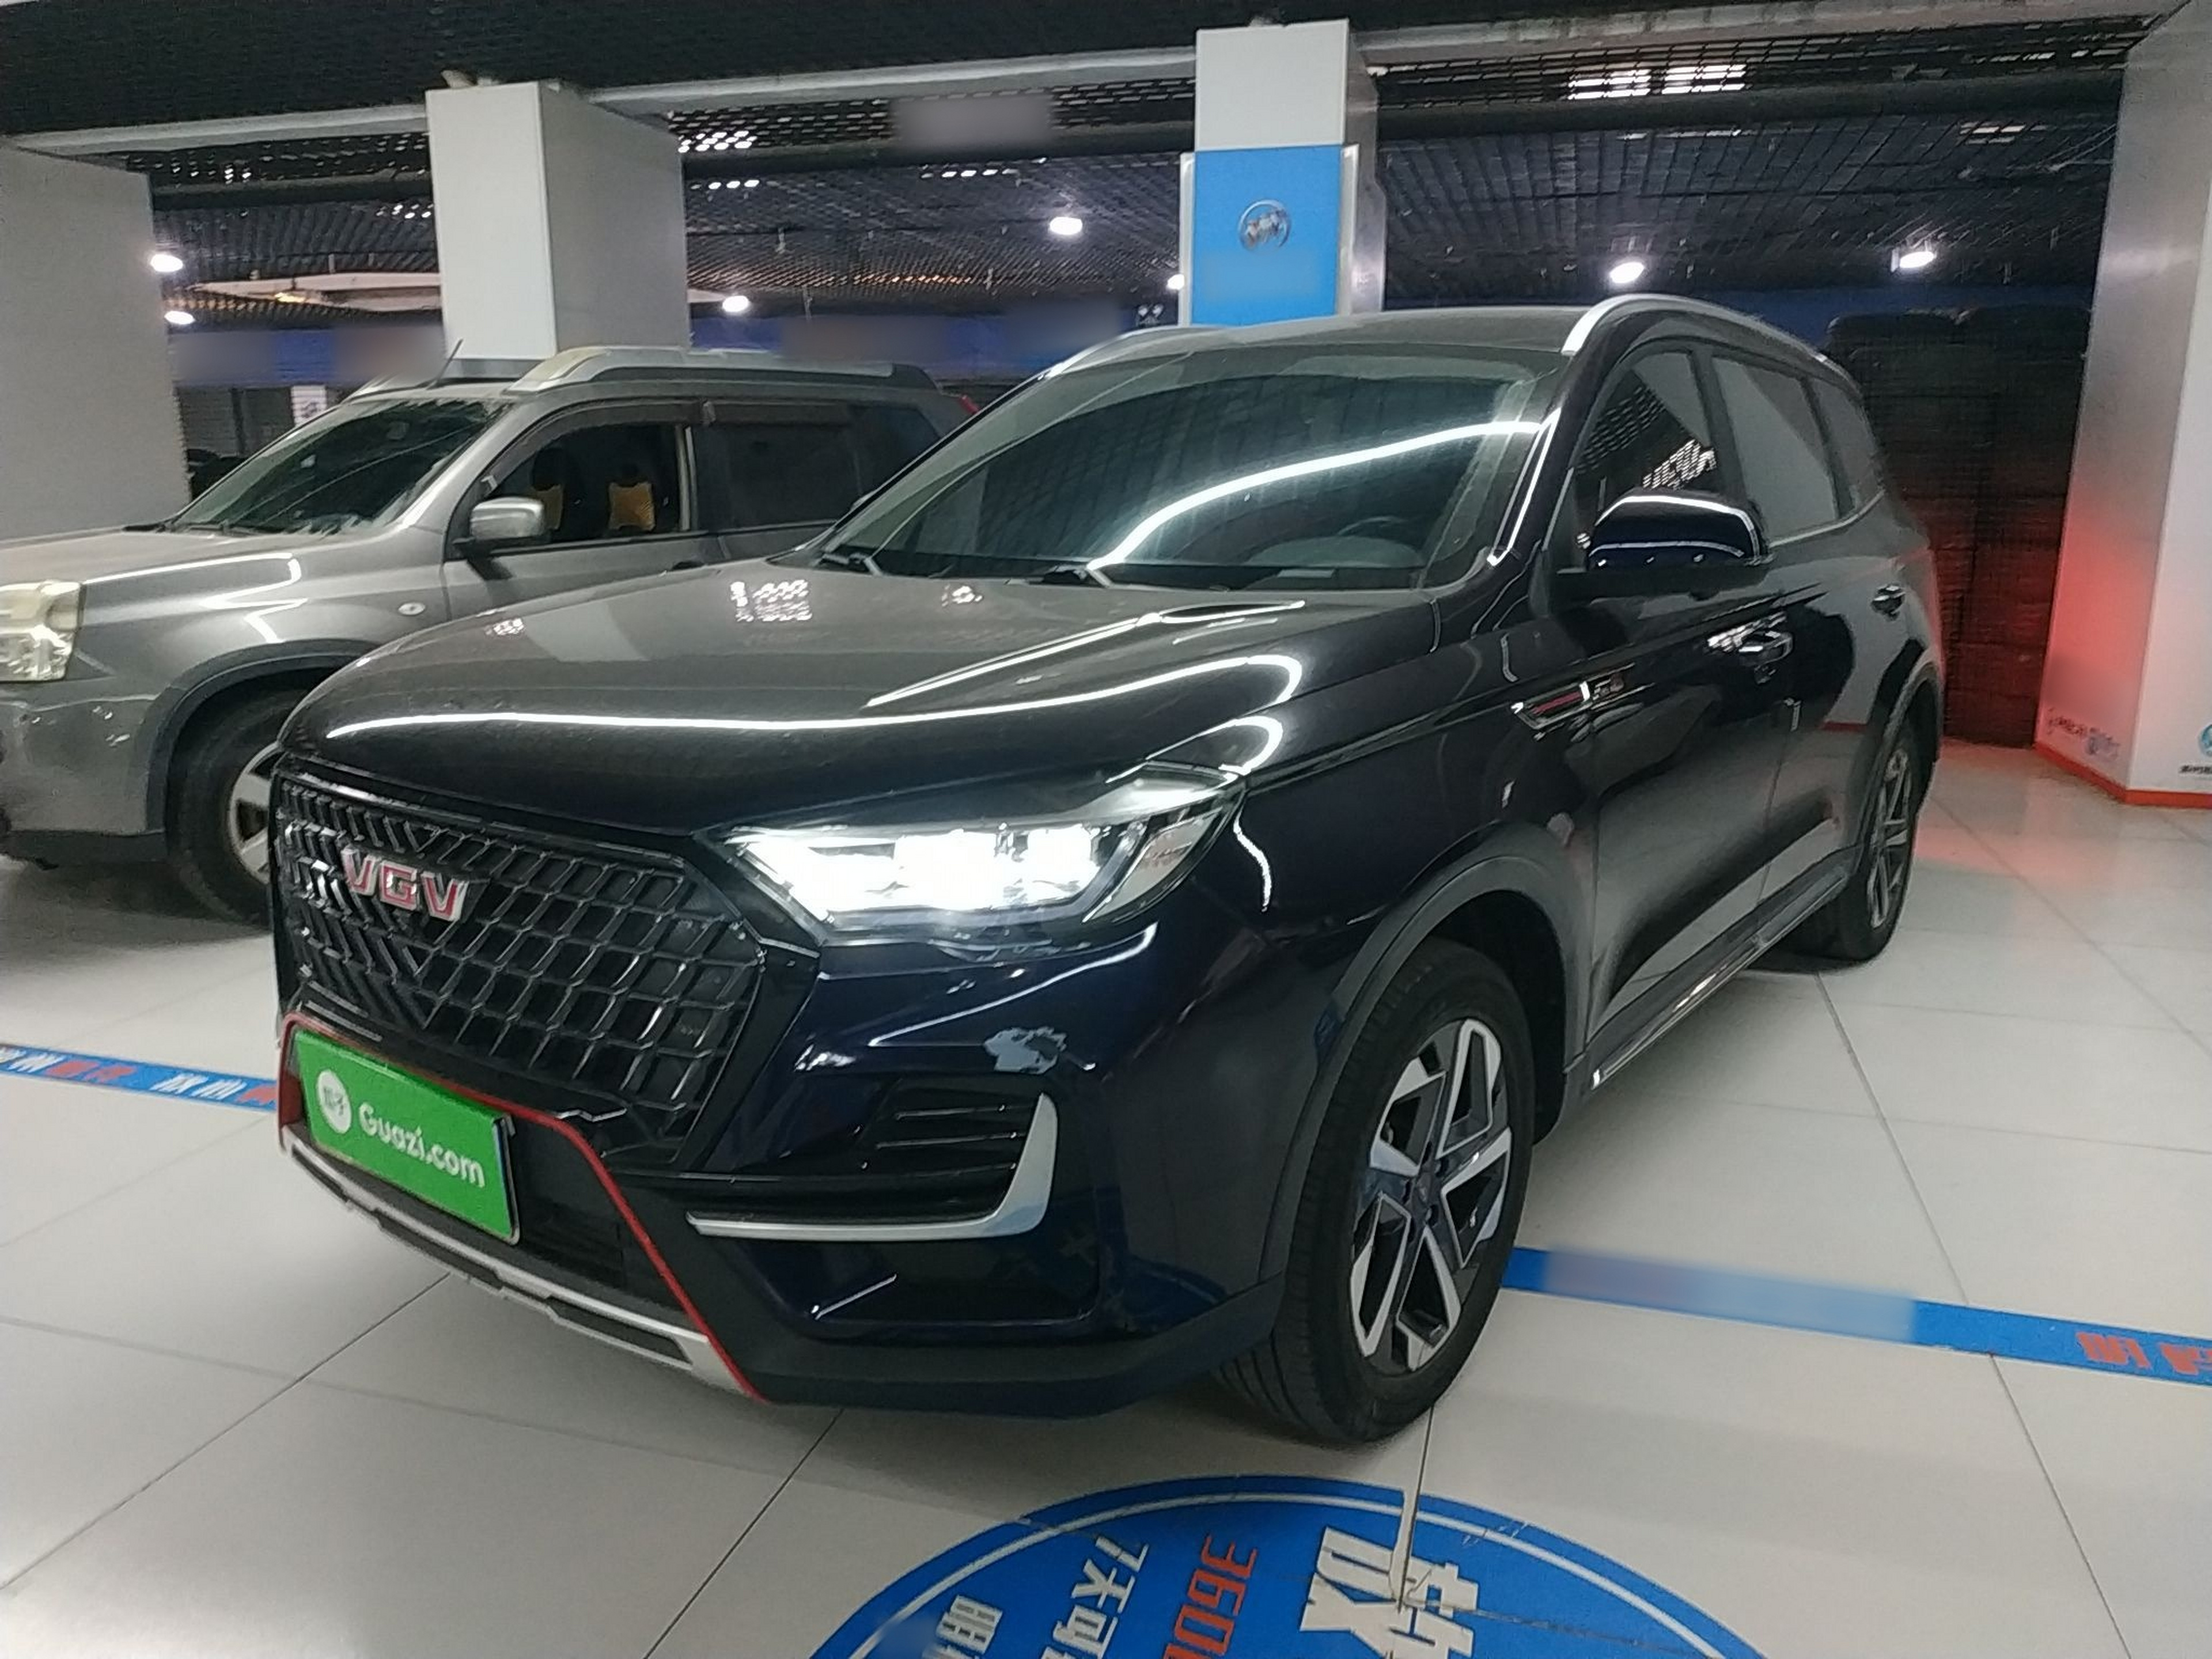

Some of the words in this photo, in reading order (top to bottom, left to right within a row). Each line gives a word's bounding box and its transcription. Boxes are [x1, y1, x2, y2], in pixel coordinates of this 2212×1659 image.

[340, 846, 469, 922] VGV
[358, 1101, 486, 1188] Guazi.com
[1300, 1527, 1479, 1659] 放
